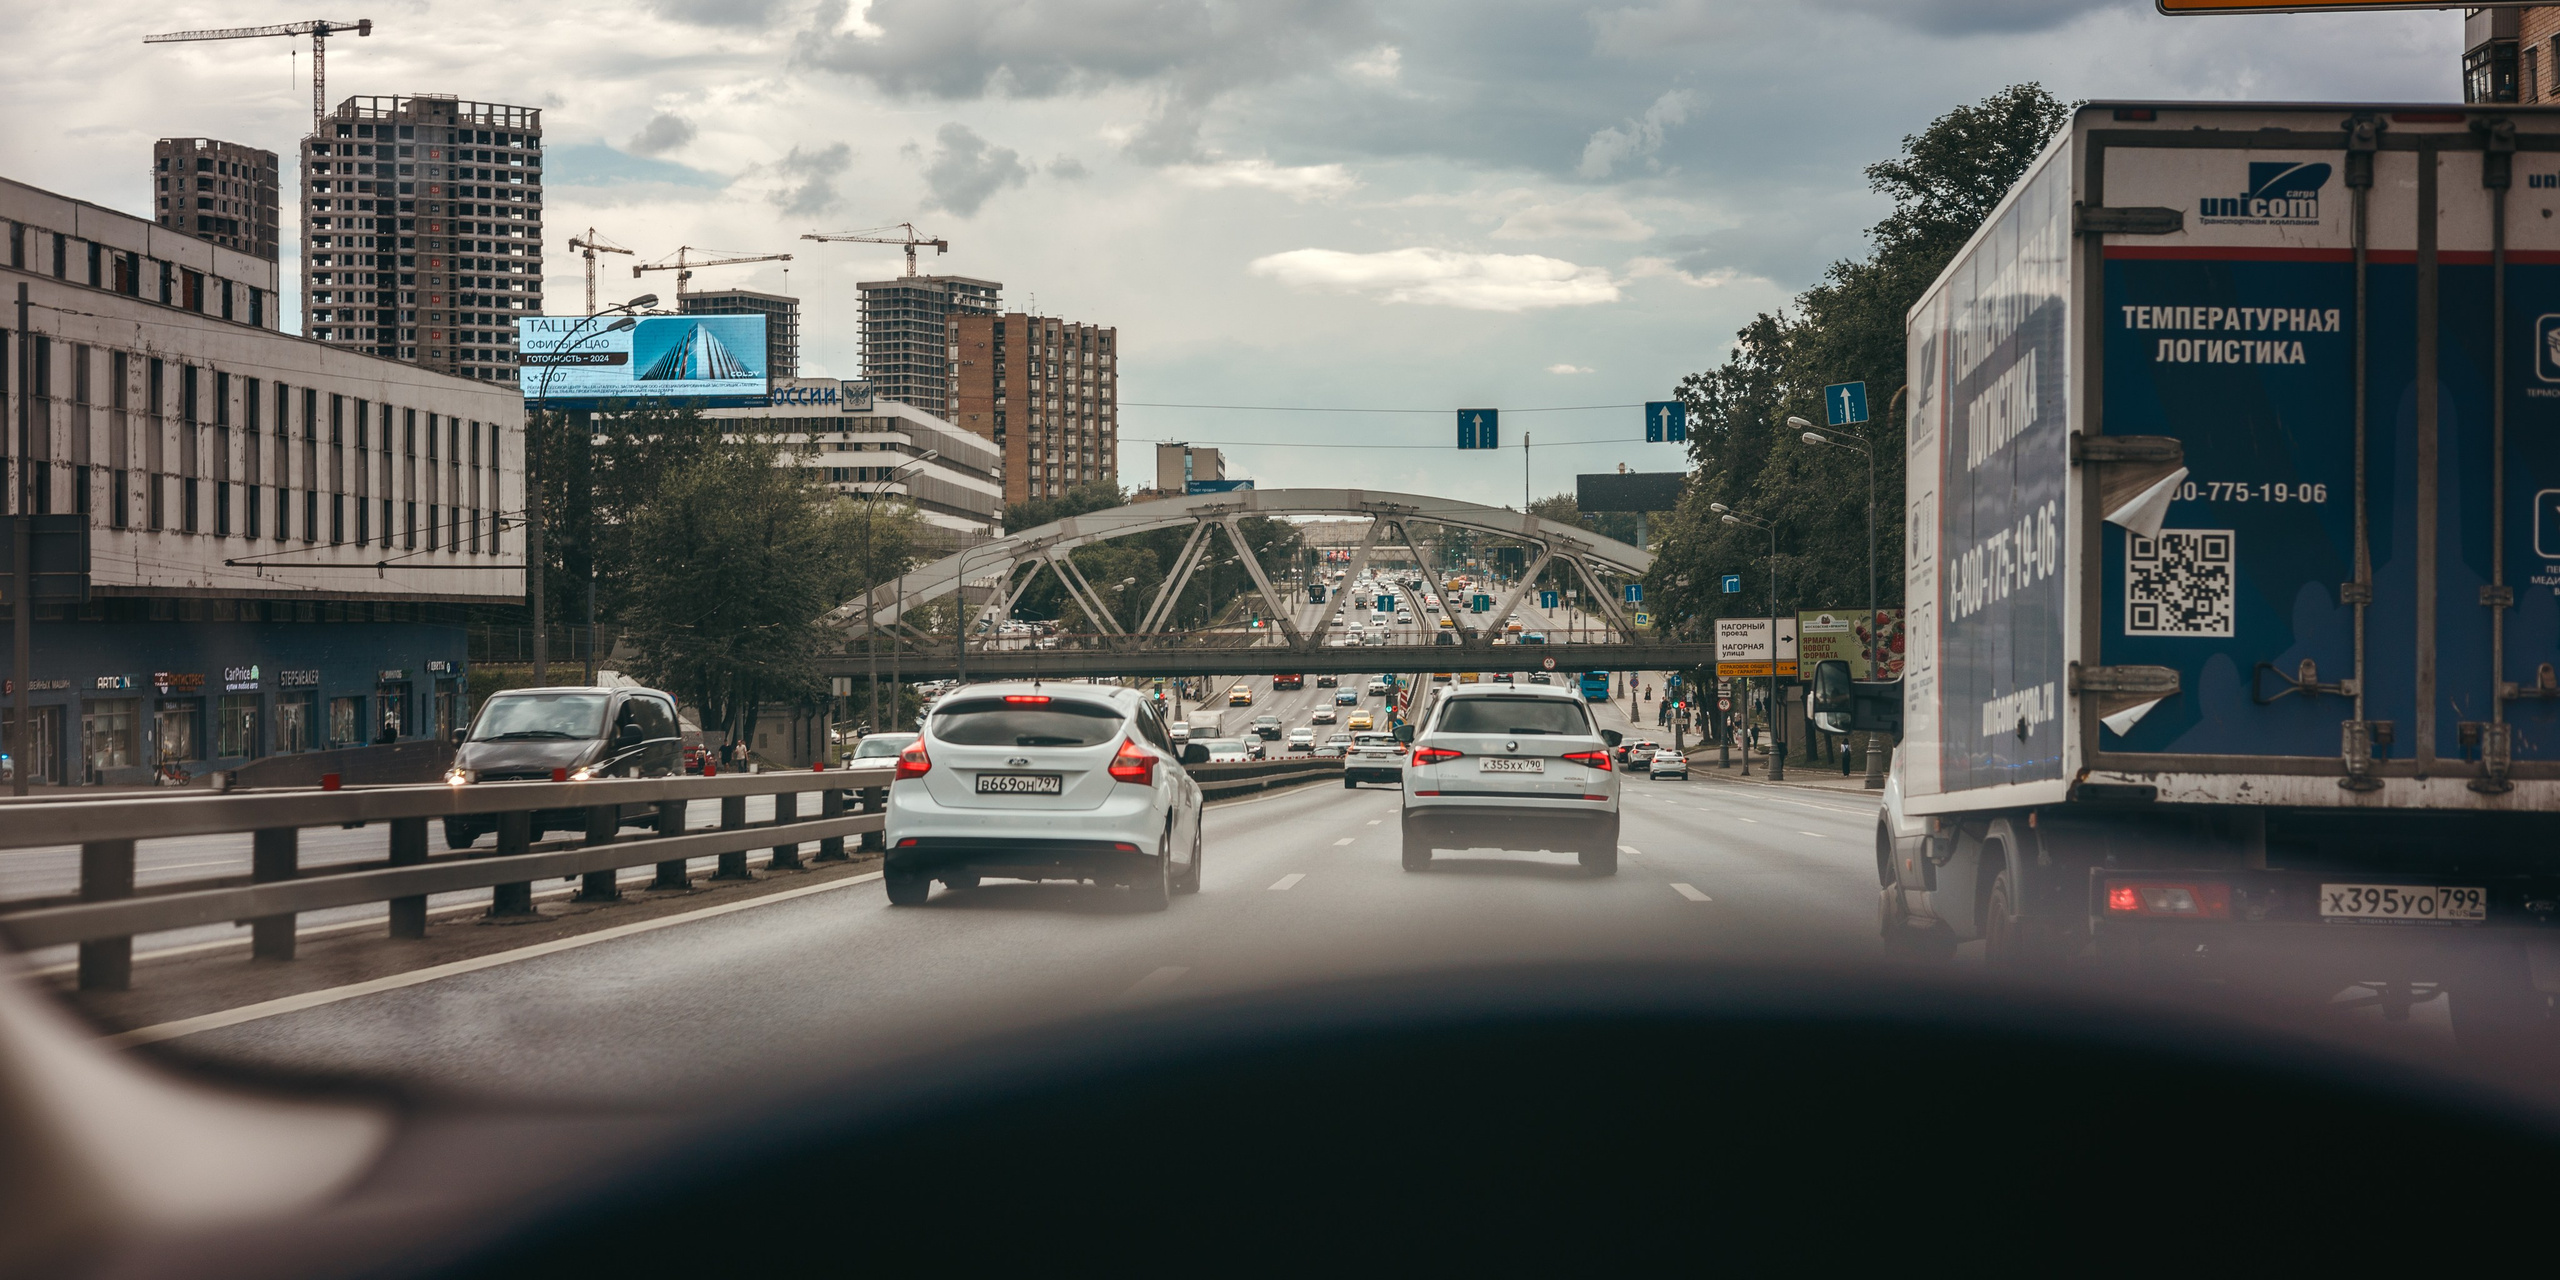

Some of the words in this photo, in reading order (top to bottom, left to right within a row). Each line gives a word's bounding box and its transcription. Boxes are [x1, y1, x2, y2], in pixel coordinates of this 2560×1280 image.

[2286, 190, 2316, 198] cargo
[2200, 192, 2317, 218] unicom
[2199, 218, 2267, 226] Транспортная
[526, 319, 598, 332] TALLER
[2122, 306, 2340, 332] ТЕМПЕРАТУРНАЯ
[526, 340, 570, 349] ОФИСЫ
[585, 340, 610, 350] ЦАО
[2156, 339, 2306, 364] ЛОГИСТИКА
[774, 387, 836, 406] ОССИИ
[1967, 347, 2038, 473] ЛОГИСТИКА
[1950, 500, 2056, 623] 8-800-775-19-06
[1721, 622, 1765, 630] НАГОРНЫЙ
[224, 666, 250, 681] CarPrice
[281, 670, 319, 686] STEPSNEAKER
[98, 676, 130, 689] ARTICON
[1982, 682, 2054, 737] unicomcargo.ru
[1484, 760, 1522, 770] К355ХХ
[982, 778, 1034, 791] В669ОН
[1038, 777, 1058, 788] 797
[2330, 888, 2434, 915] Х395УО
[2439, 889, 2480, 910] 799
[2449, 909, 2468, 918] RUS
